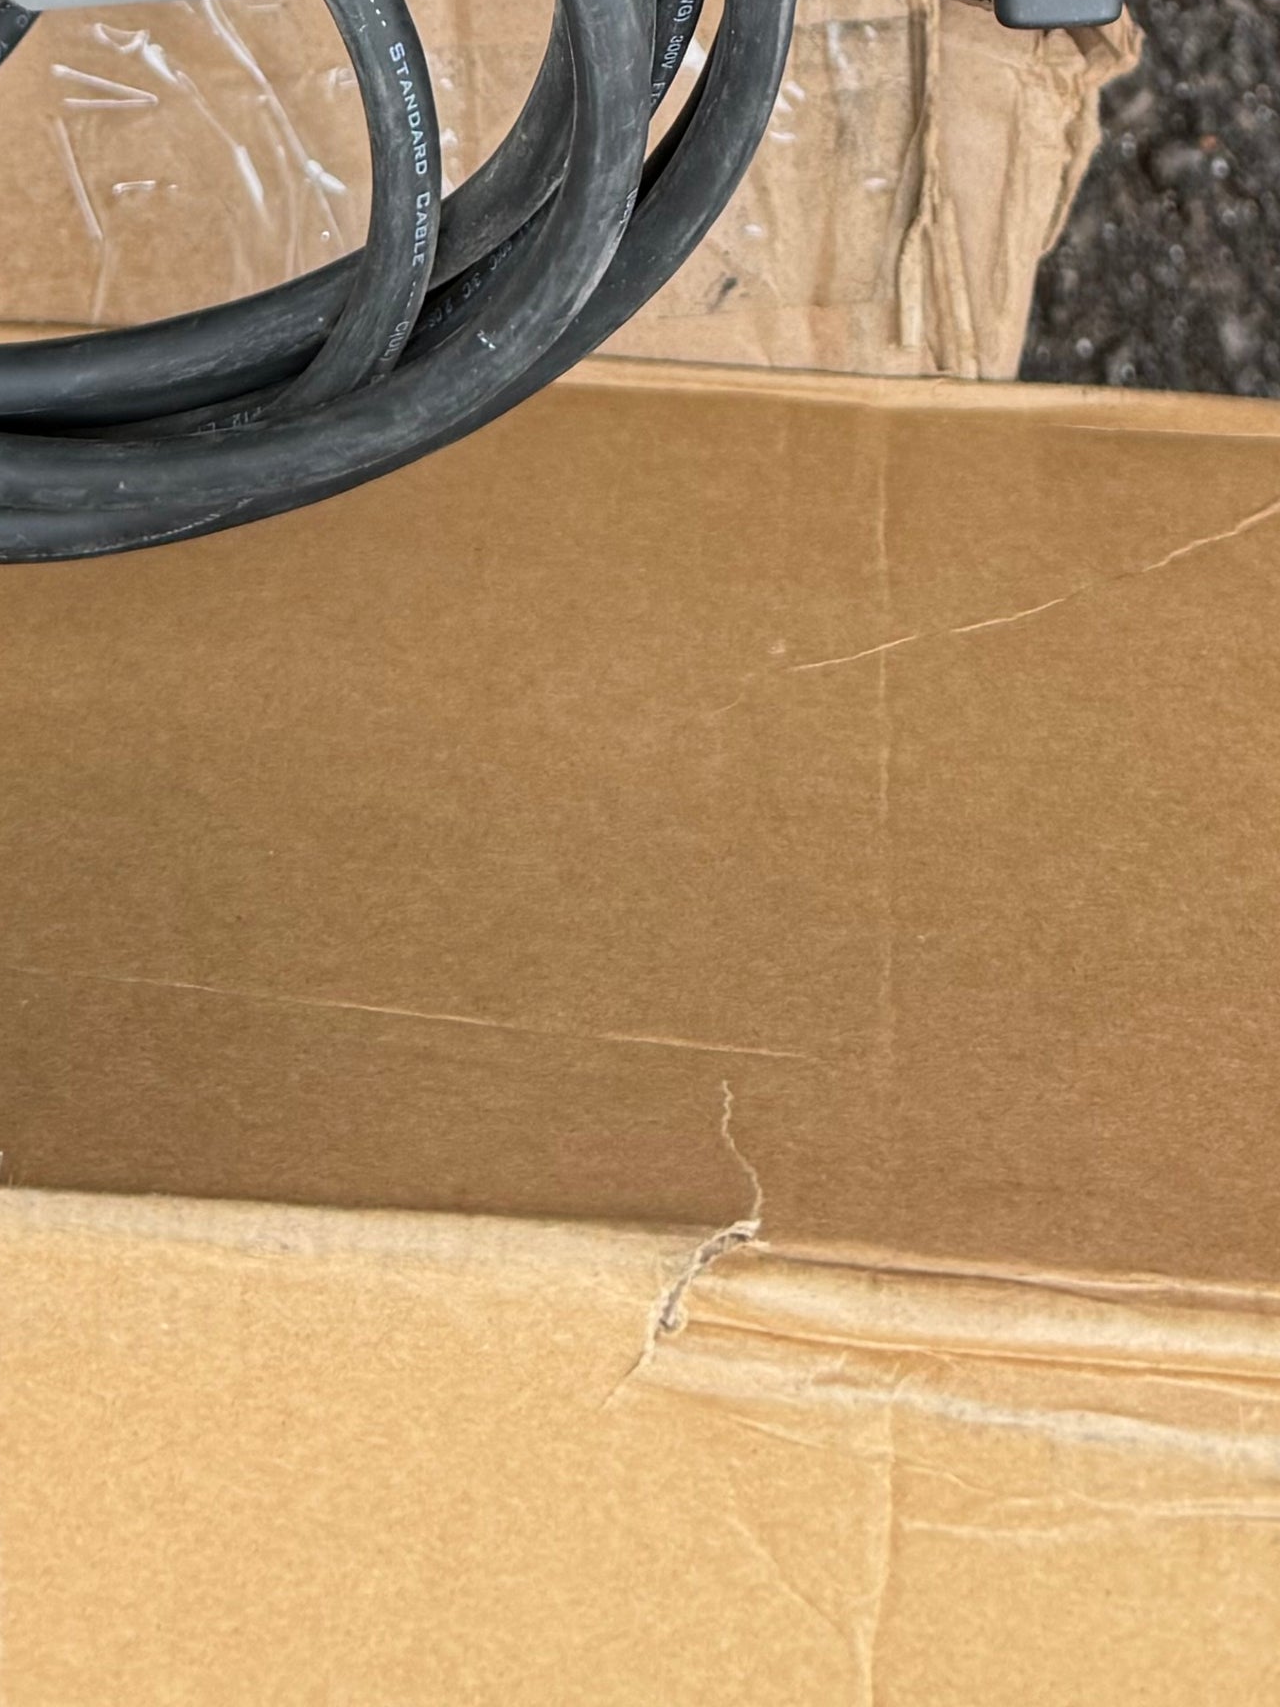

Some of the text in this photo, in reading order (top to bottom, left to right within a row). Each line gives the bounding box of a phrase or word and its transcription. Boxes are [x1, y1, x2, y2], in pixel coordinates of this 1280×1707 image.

[660, 35, 684, 70] 300V
[389, 42, 428, 176] STANDARD
[411, 191, 431, 267] CABLE
